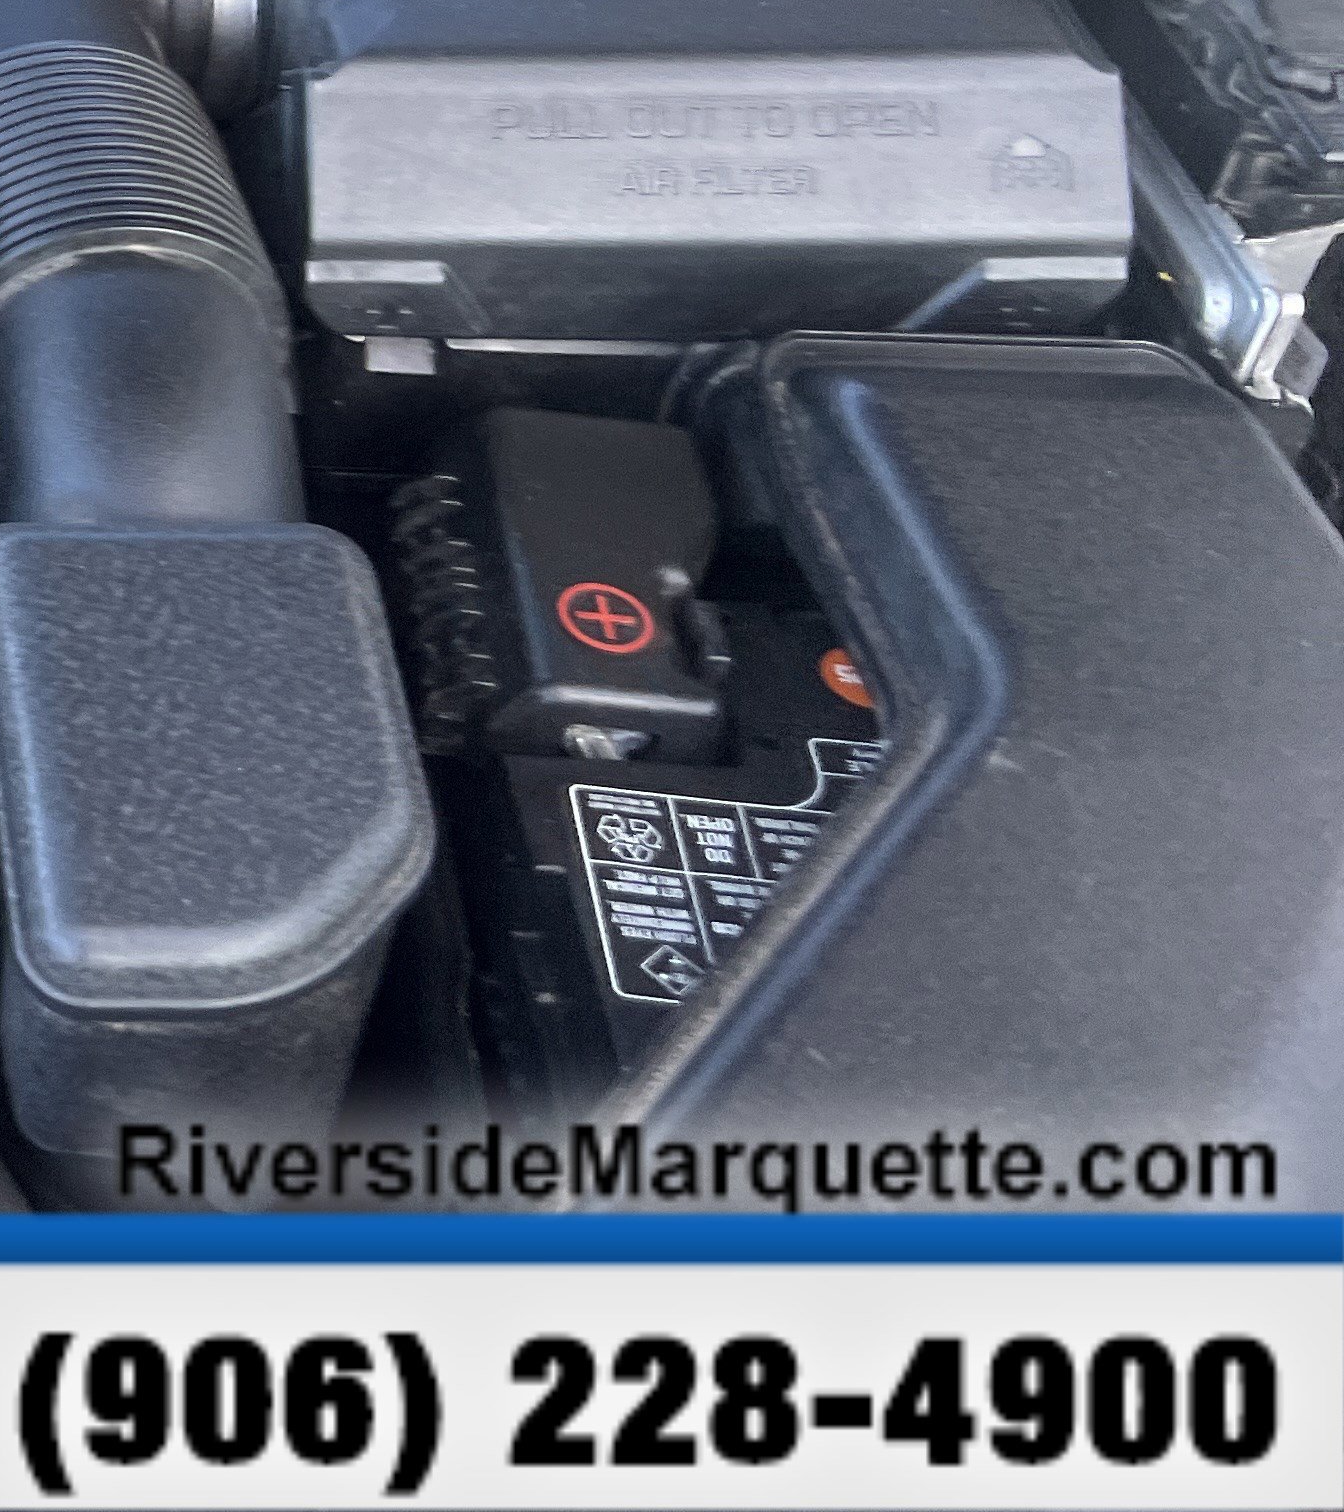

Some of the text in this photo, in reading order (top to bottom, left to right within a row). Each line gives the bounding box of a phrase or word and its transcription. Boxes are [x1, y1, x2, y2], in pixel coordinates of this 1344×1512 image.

[490, 99, 941, 140] PULL OUT TO OPEN
[614, 164, 819, 197] AIR FILTER
[695, 830, 734, 849] NOT
